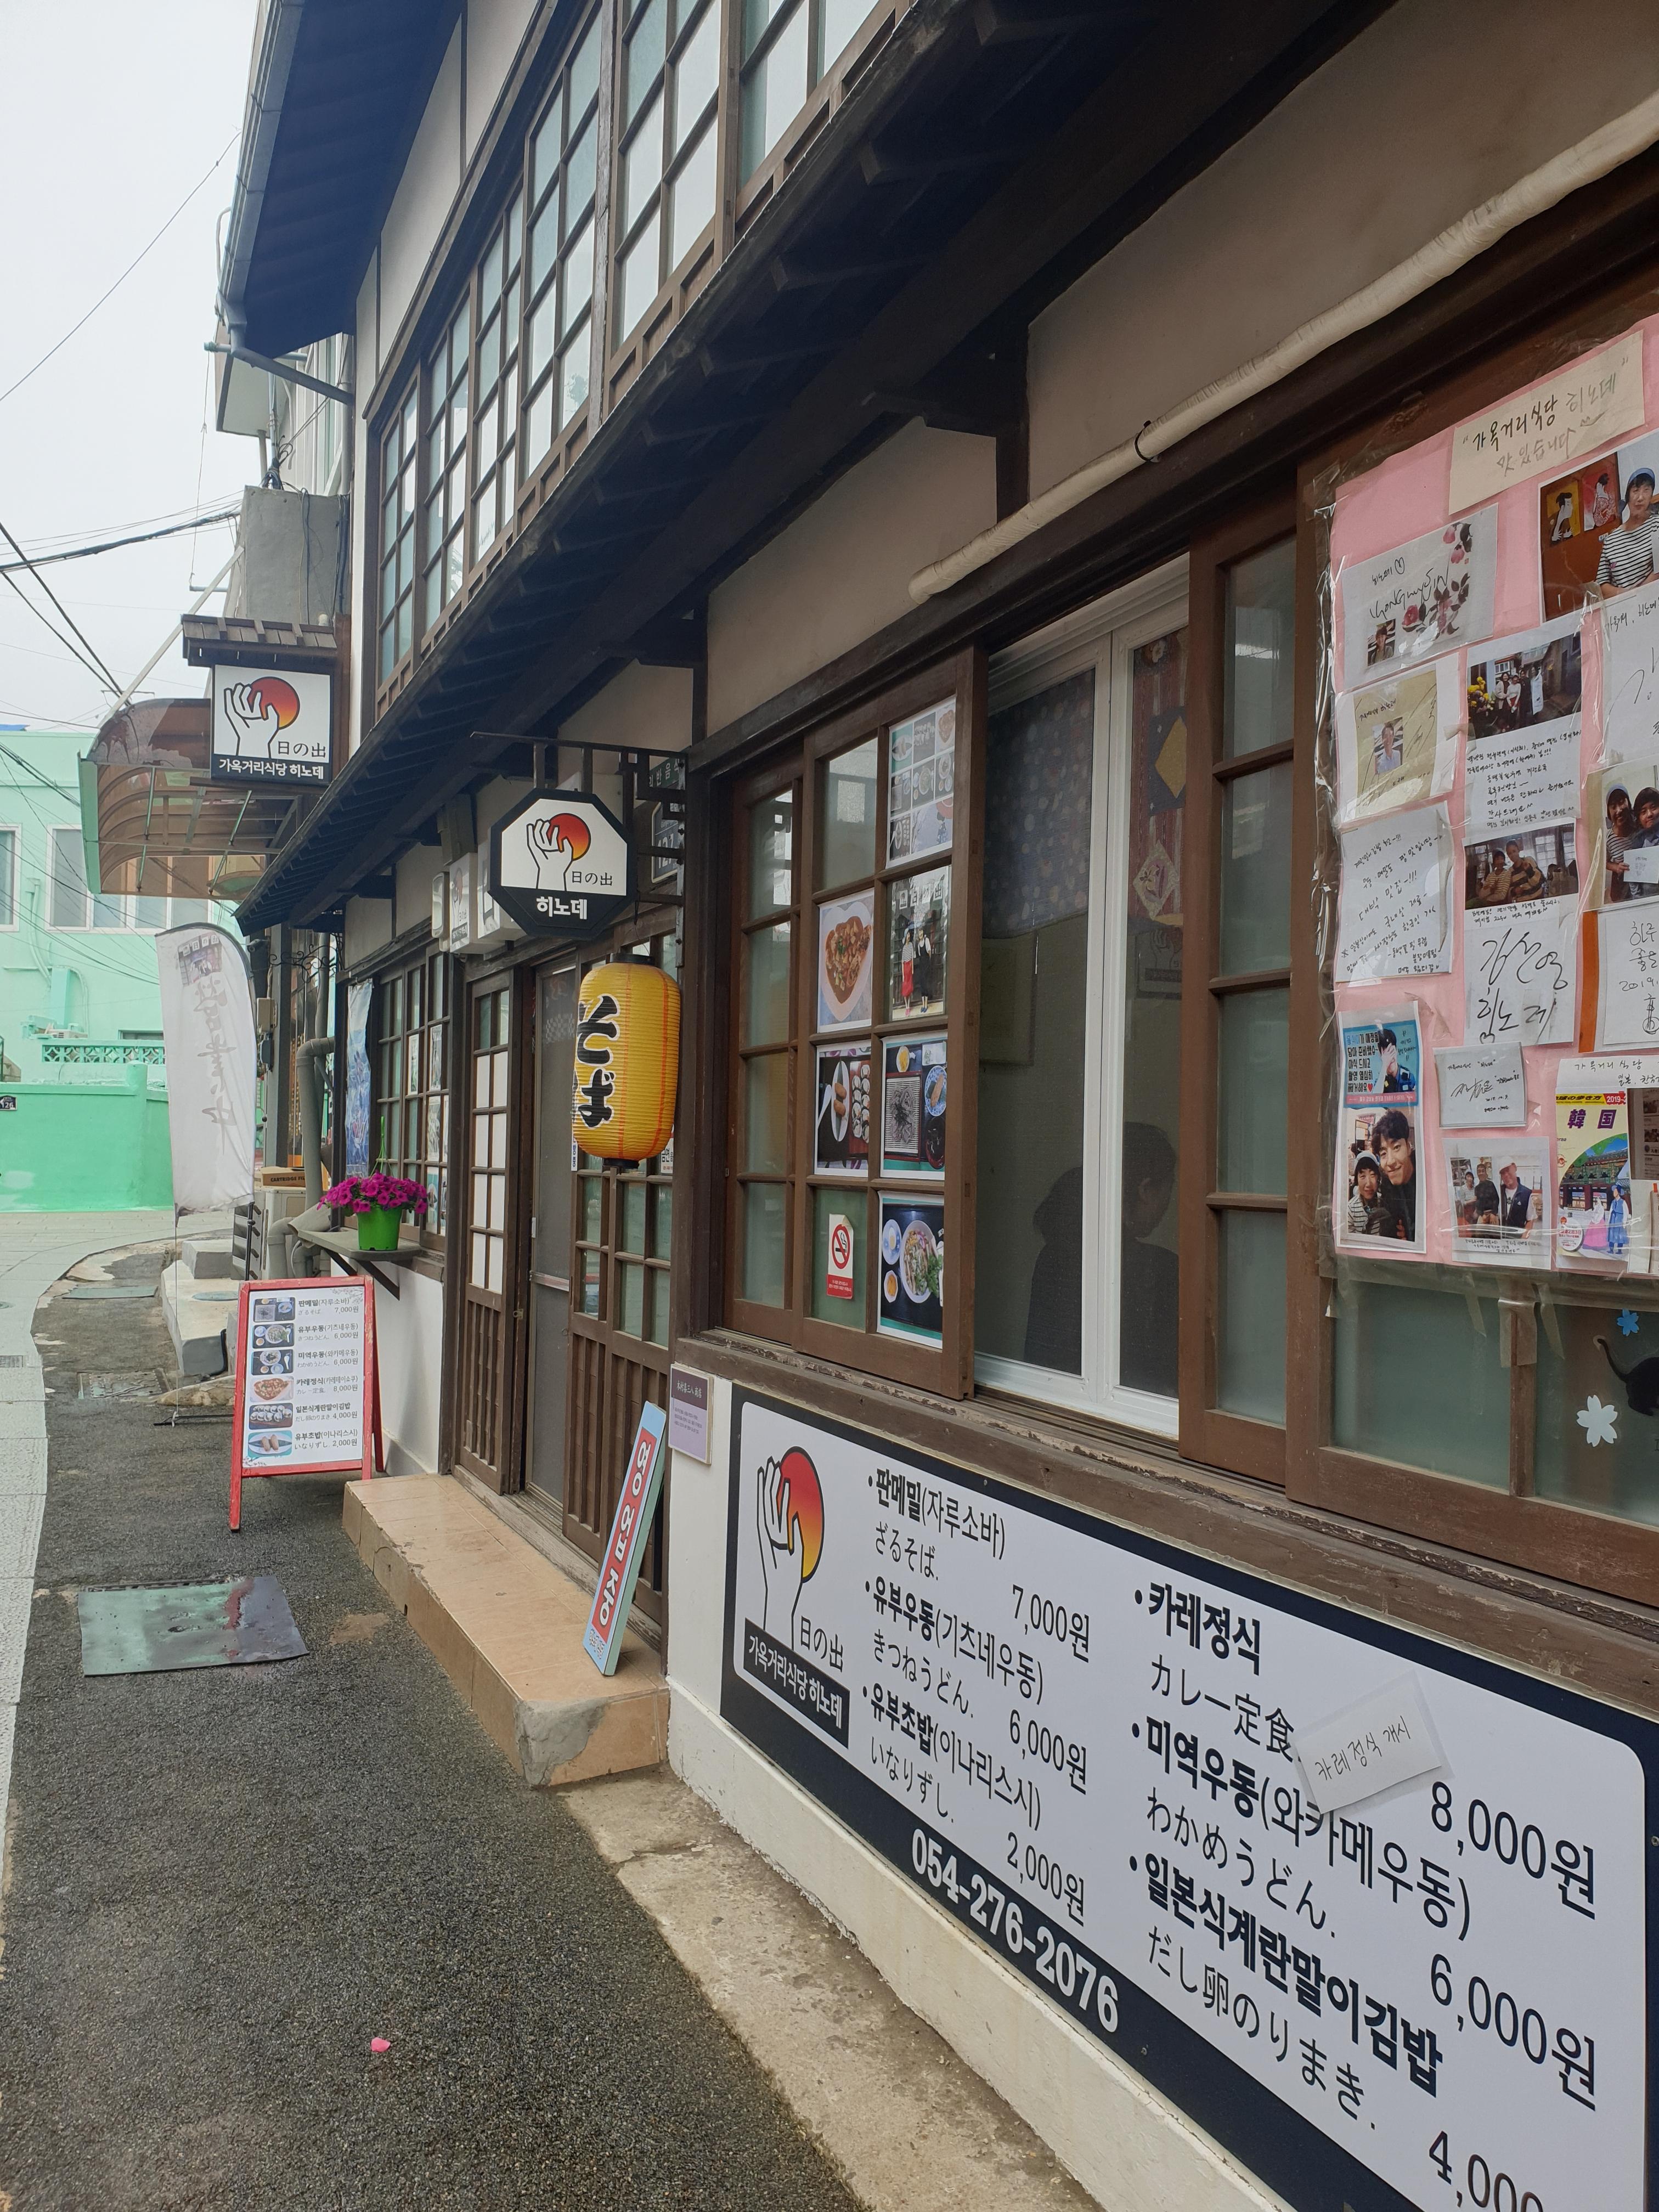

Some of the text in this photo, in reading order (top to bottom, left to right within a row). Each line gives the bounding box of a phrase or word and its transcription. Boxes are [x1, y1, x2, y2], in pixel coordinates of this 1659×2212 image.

[219, 759, 324, 780] 가옥거리식당 히노데
[278, 741, 326, 758] 日の出
[536, 896, 587, 920] 히노데
[572, 871, 613, 886] 日の出
[334, 1331, 358, 1340] 6,000원
[335, 1306, 359, 1314] 7,000원
[333, 1384, 358, 1393] 8,000원
[334, 1358, 358, 1367] 6,000원
[332, 1411, 357, 1420] 4,000원
[332, 1438, 357, 1447] 2,000원
[599, 1440, 651, 1628] 영업중
[876, 1468, 1006, 1560] 판메밀(자루소바)
[800, 1616, 844, 1673] 日の出
[872, 1579, 1044, 1705] 유부우동(기츠네우동)
[1012, 1584, 1090, 1663] 7,000원
[1148, 1582, 1261, 1677] 카레정식
[748, 1632, 843, 1730] 가옥거리식당 히노데
[870, 1686, 1041, 1831] 유부초밥(이나리스시)
[1009, 1709, 1087, 1795] 6,000원
[1383, 1715, 1411, 1743] 개시
[1007, 1831, 1085, 1927] 2,000원
[1430, 1781, 1595, 1920] 8,000원
[911, 1828, 1119, 2033] 054-276-2076
[1145, 1852, 1443, 2098] 일본식계란말이김밥
[1430, 1954, 1596, 2112] 6,000원
